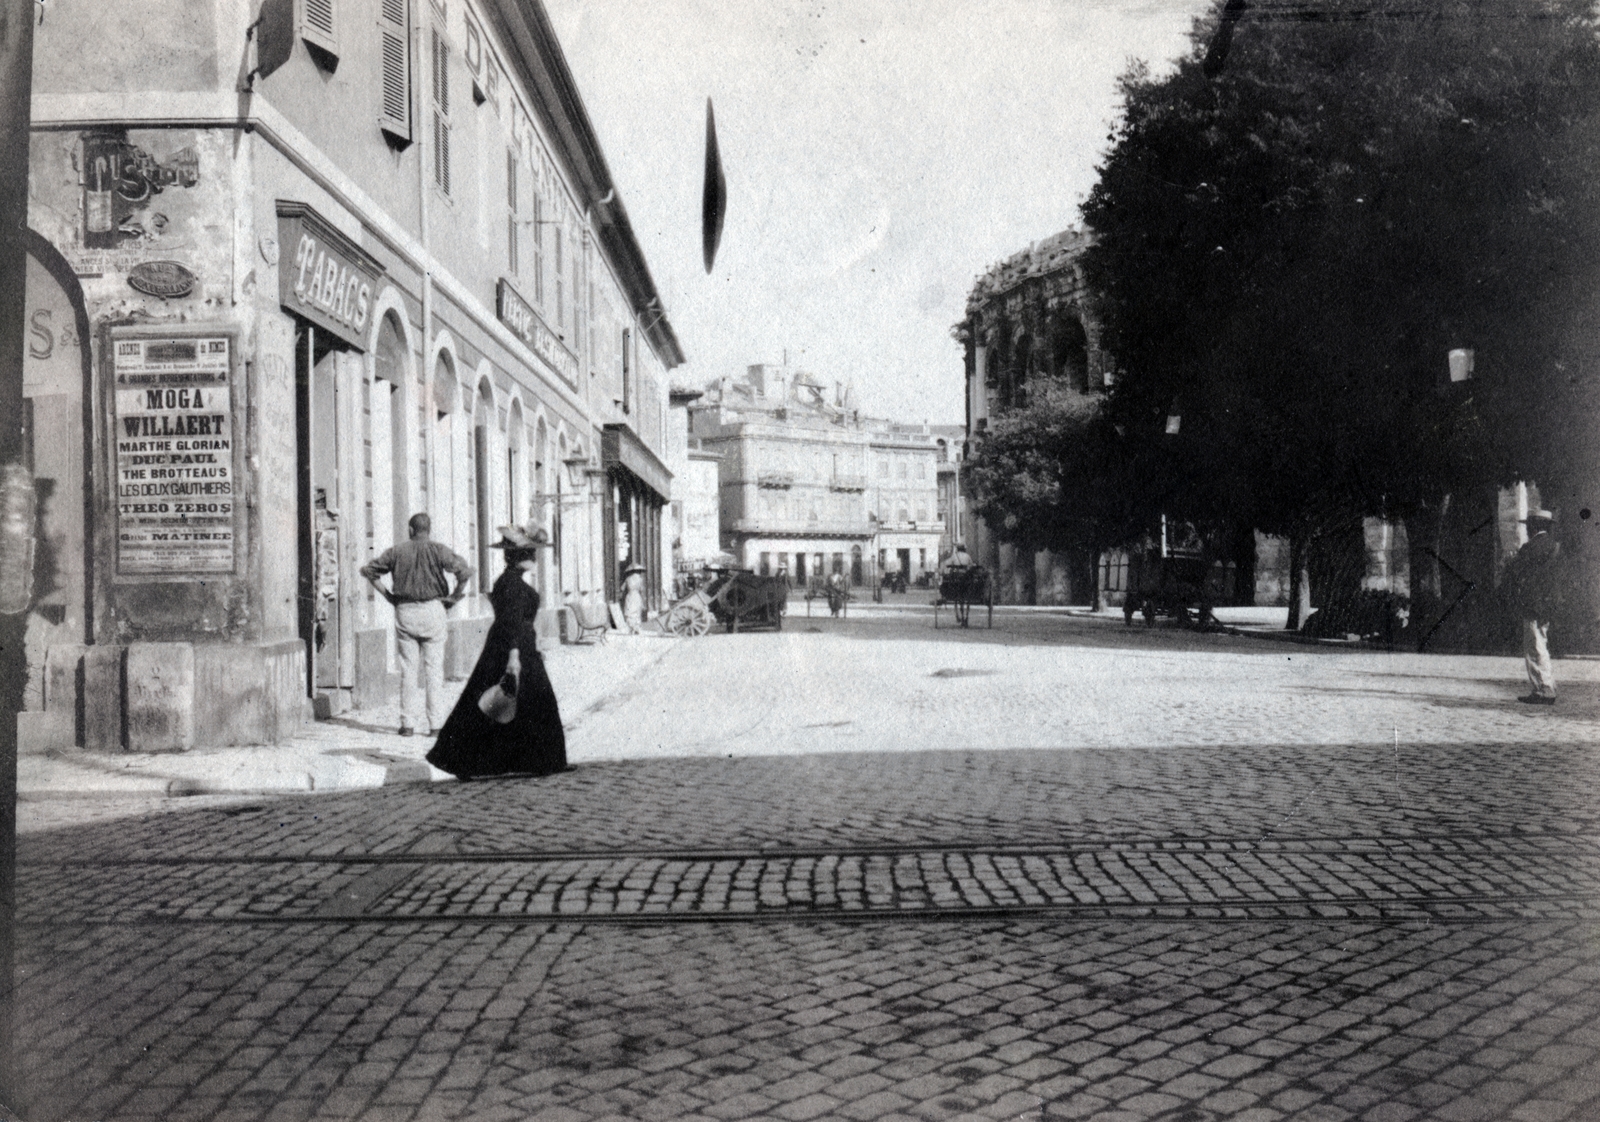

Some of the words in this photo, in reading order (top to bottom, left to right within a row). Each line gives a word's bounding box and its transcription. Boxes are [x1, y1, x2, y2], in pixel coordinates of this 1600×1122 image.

[295, 233, 370, 330] TABACS
[146, 389, 204, 410] MOGA
[123, 414, 225, 438] WILLAERT
[119, 441, 172, 452] MARTHE
[176, 439, 230, 451] GLORIAN
[131, 455, 166, 465] DUC
[169, 453, 218, 464] PAUL
[122, 469, 147, 480] THE
[119, 484, 140, 497] LES
[140, 483, 169, 496] DEUX
[120, 503, 170, 514] THEO
[152, 532, 232, 541] MATINEE
